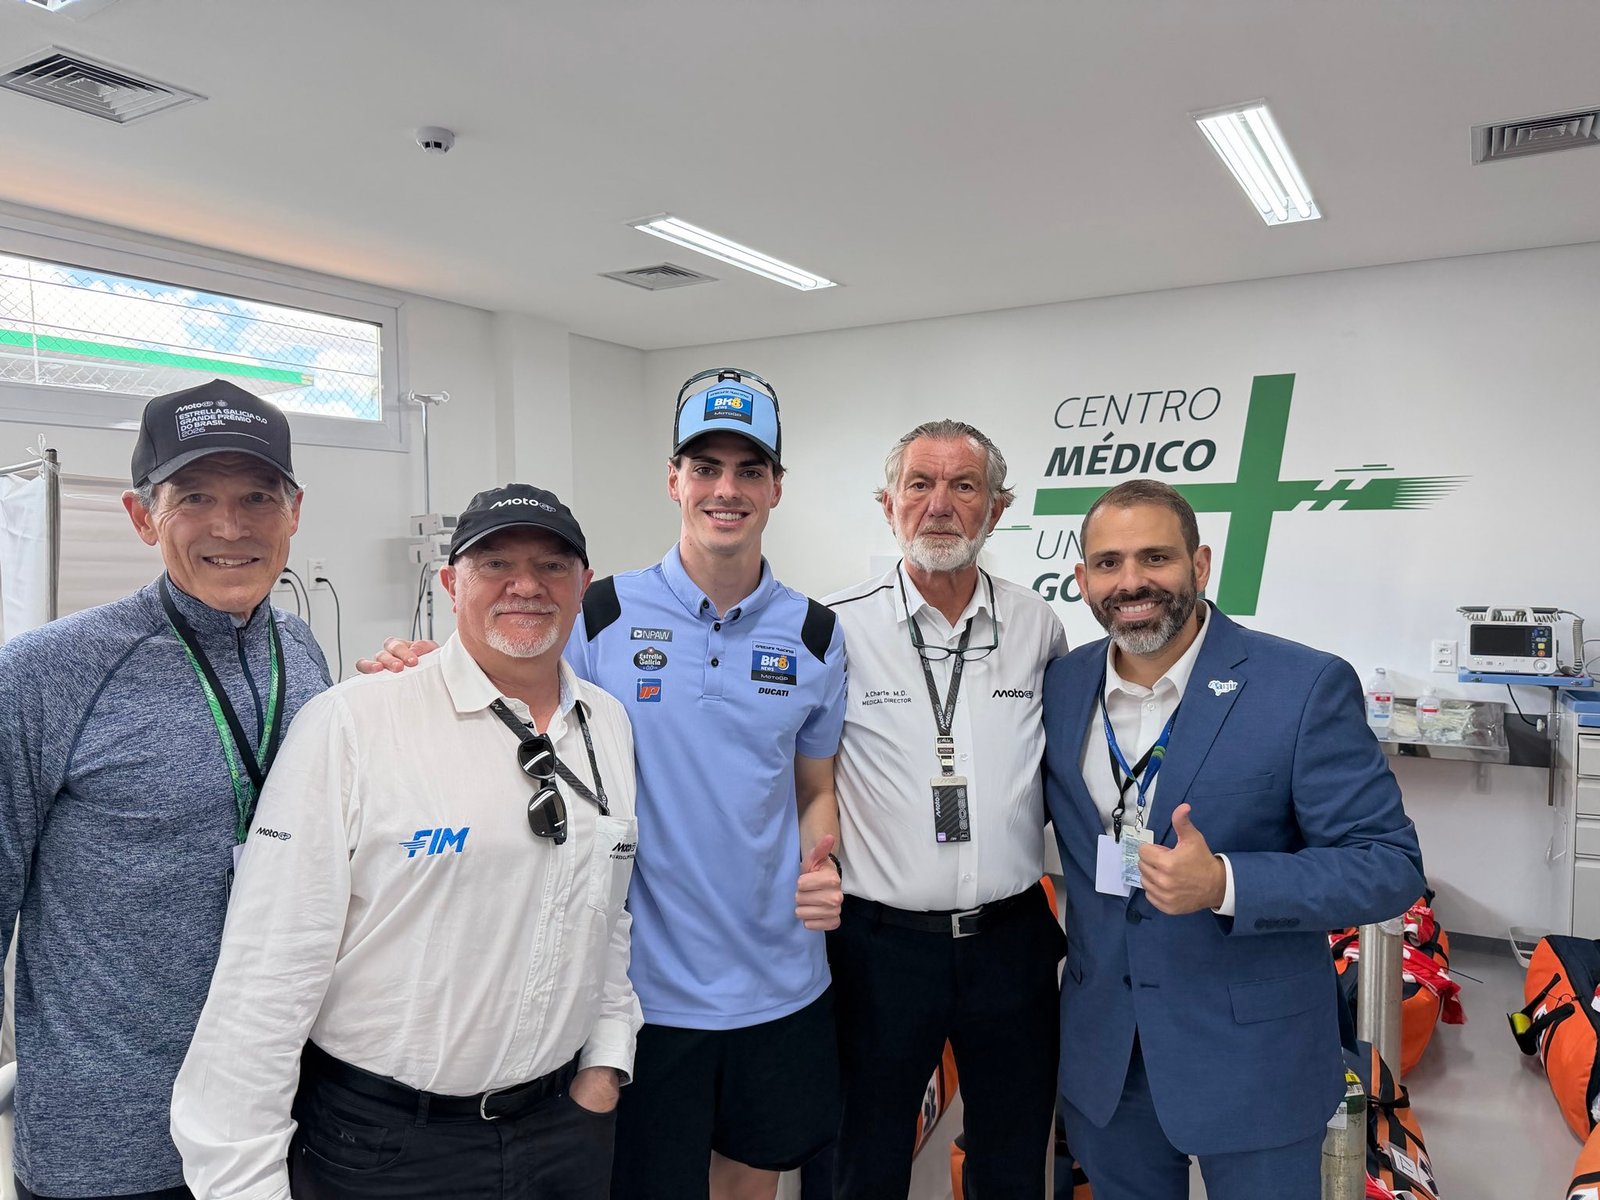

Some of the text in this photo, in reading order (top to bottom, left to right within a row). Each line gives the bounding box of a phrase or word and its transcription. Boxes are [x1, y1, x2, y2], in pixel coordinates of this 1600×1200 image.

[179, 409, 222, 420] ESTRELLA
[223, 408, 255, 419] GALICIA
[1054, 387, 1221, 429] CENTRO
[180, 413, 252, 426] GRANDE PRÊMIO
[180, 420, 226, 432] DO BRASIL
[181, 427, 206, 437] 2026
[1044, 431, 1217, 477] MÉDICO
[642, 630, 670, 640] NPAW
[760, 655, 790, 671] BK8
[758, 687, 789, 697] DUCATI
[399, 827, 470, 858] FIM
